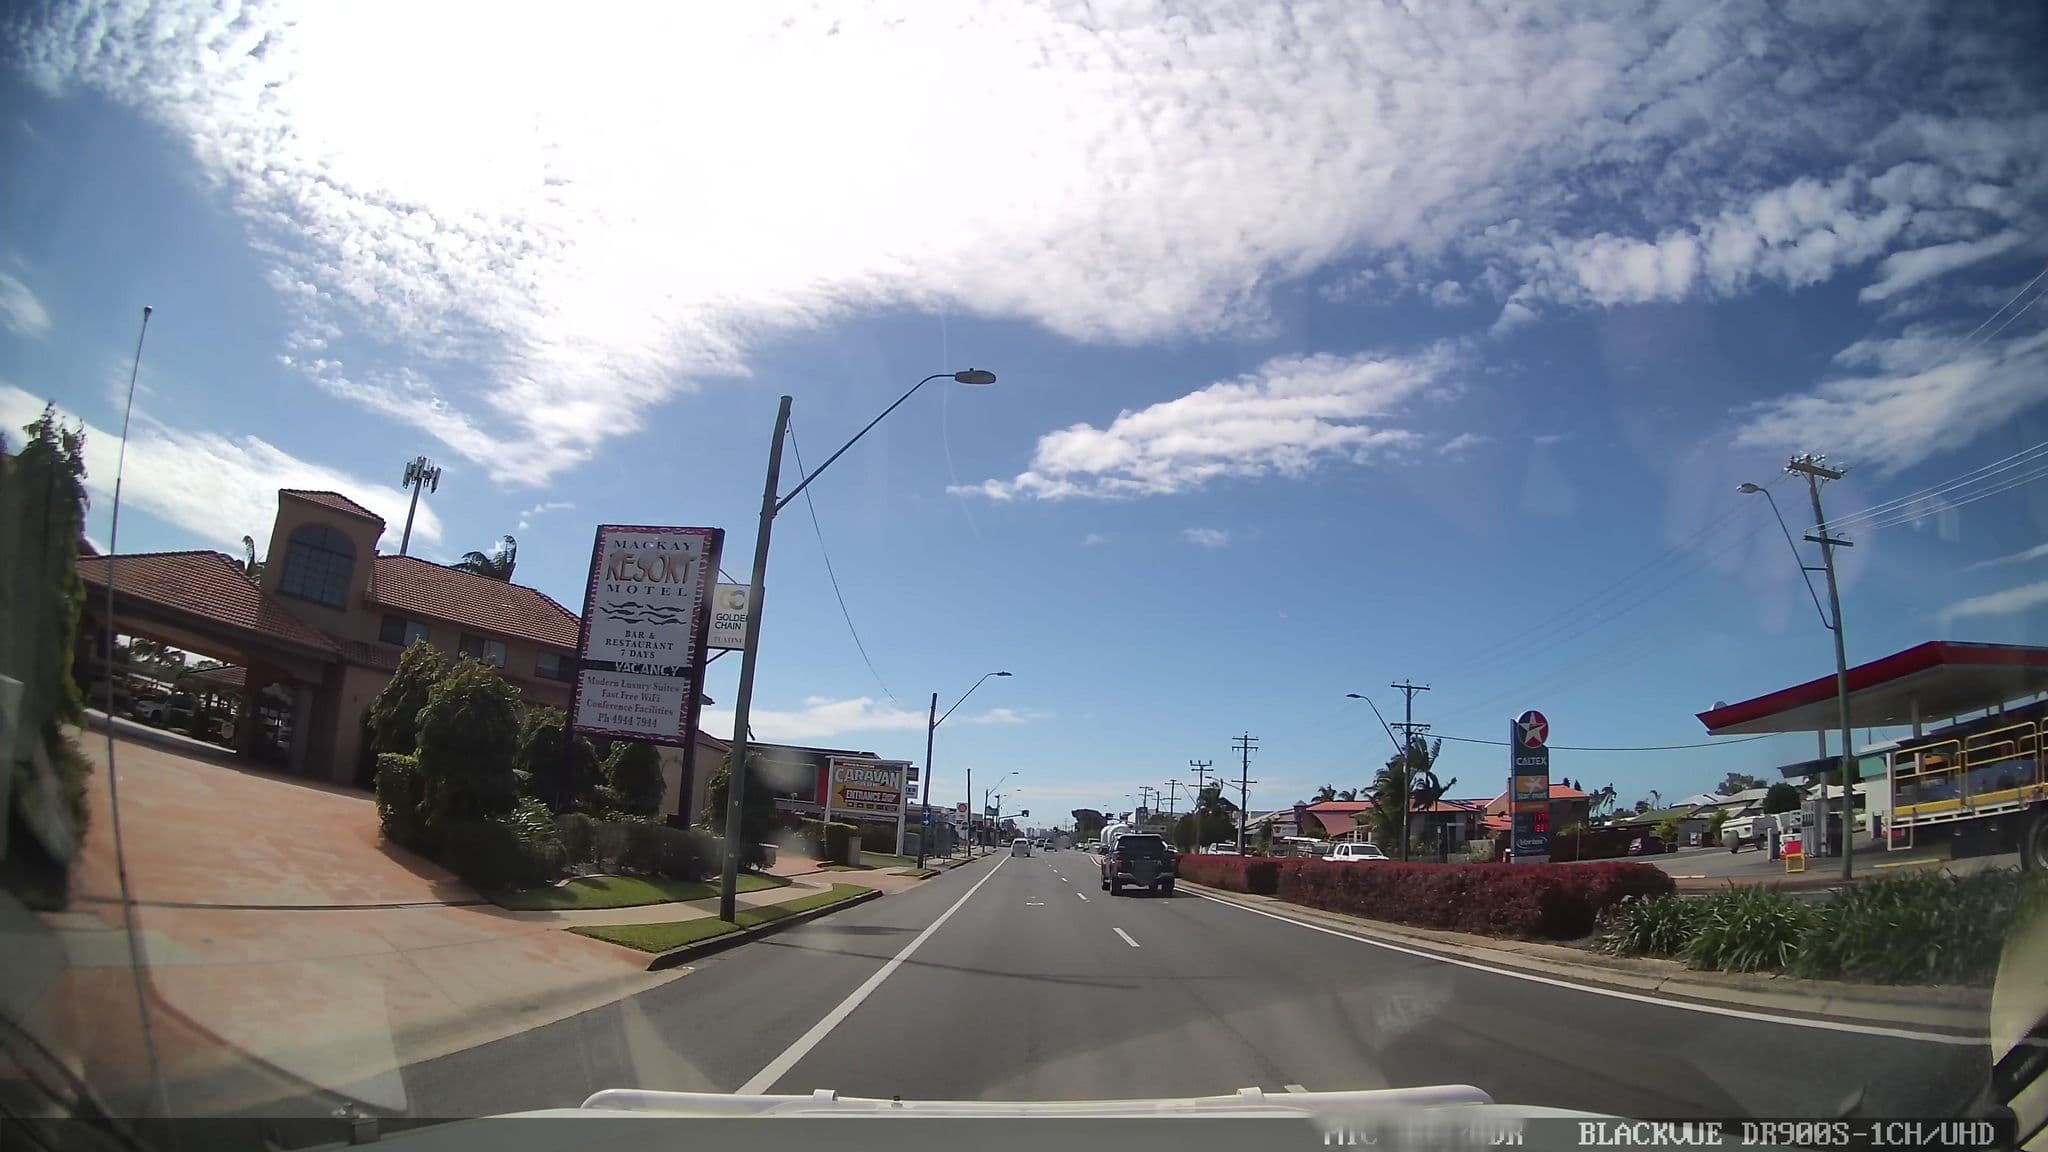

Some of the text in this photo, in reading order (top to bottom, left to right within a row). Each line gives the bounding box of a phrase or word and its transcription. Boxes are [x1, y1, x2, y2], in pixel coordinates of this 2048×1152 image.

[614, 540, 693, 551] MACKAY
[606, 552, 697, 584] RESORT
[606, 584, 688, 597] MOTEL
[714, 621, 742, 630] CHAIN
[625, 630, 655, 640] BAR &
[605, 638, 674, 650] RESTAURANT
[620, 649, 655, 659] 7 DAYS
[615, 661, 680, 677] VACANCY
[587, 676, 680, 693] Modern Luxury Suites
[601, 688, 661, 702] Fast Free WiFi
[586, 699, 674, 716] Conference Facilities
[597, 712, 610, 723] Ph
[1516, 756, 1547, 766] CALTEX
[835, 767, 900, 790] CARAVAN
[846, 789, 880, 802] ENTRANCE
